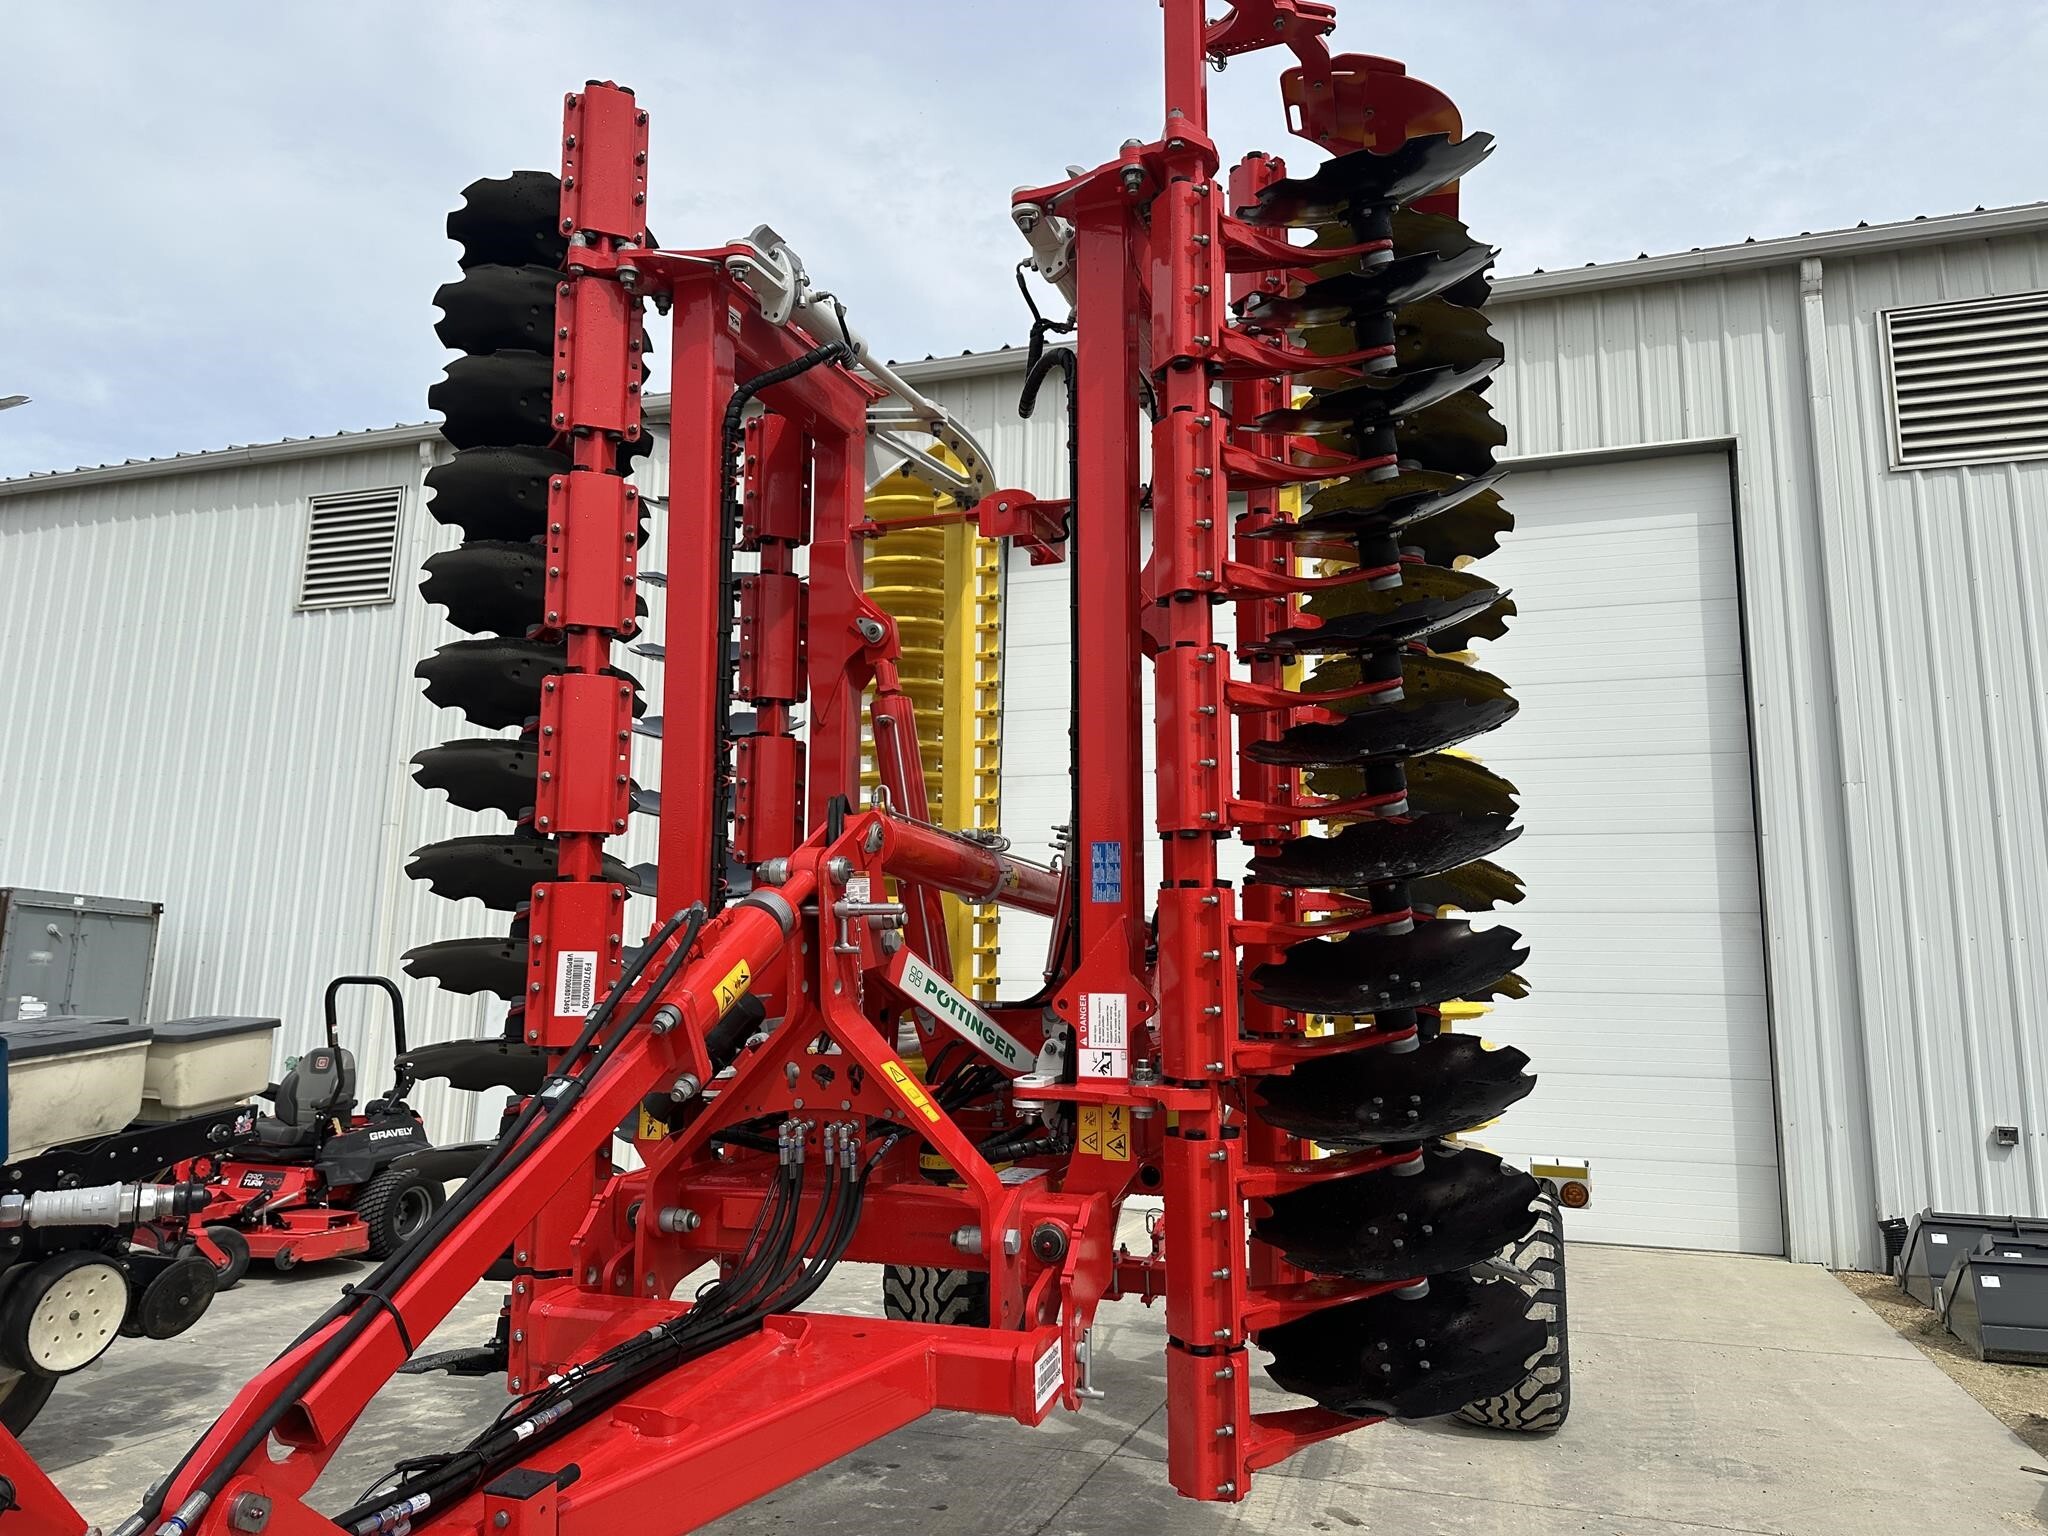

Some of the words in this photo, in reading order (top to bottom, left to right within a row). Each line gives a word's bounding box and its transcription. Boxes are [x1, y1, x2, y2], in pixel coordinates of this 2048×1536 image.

[1079, 994, 1087, 1032] DANGER
[369, 1127, 413, 1141] GRAVELY
[245, 1173, 265, 1181] PRO-
[243, 1179, 264, 1187] TURN
